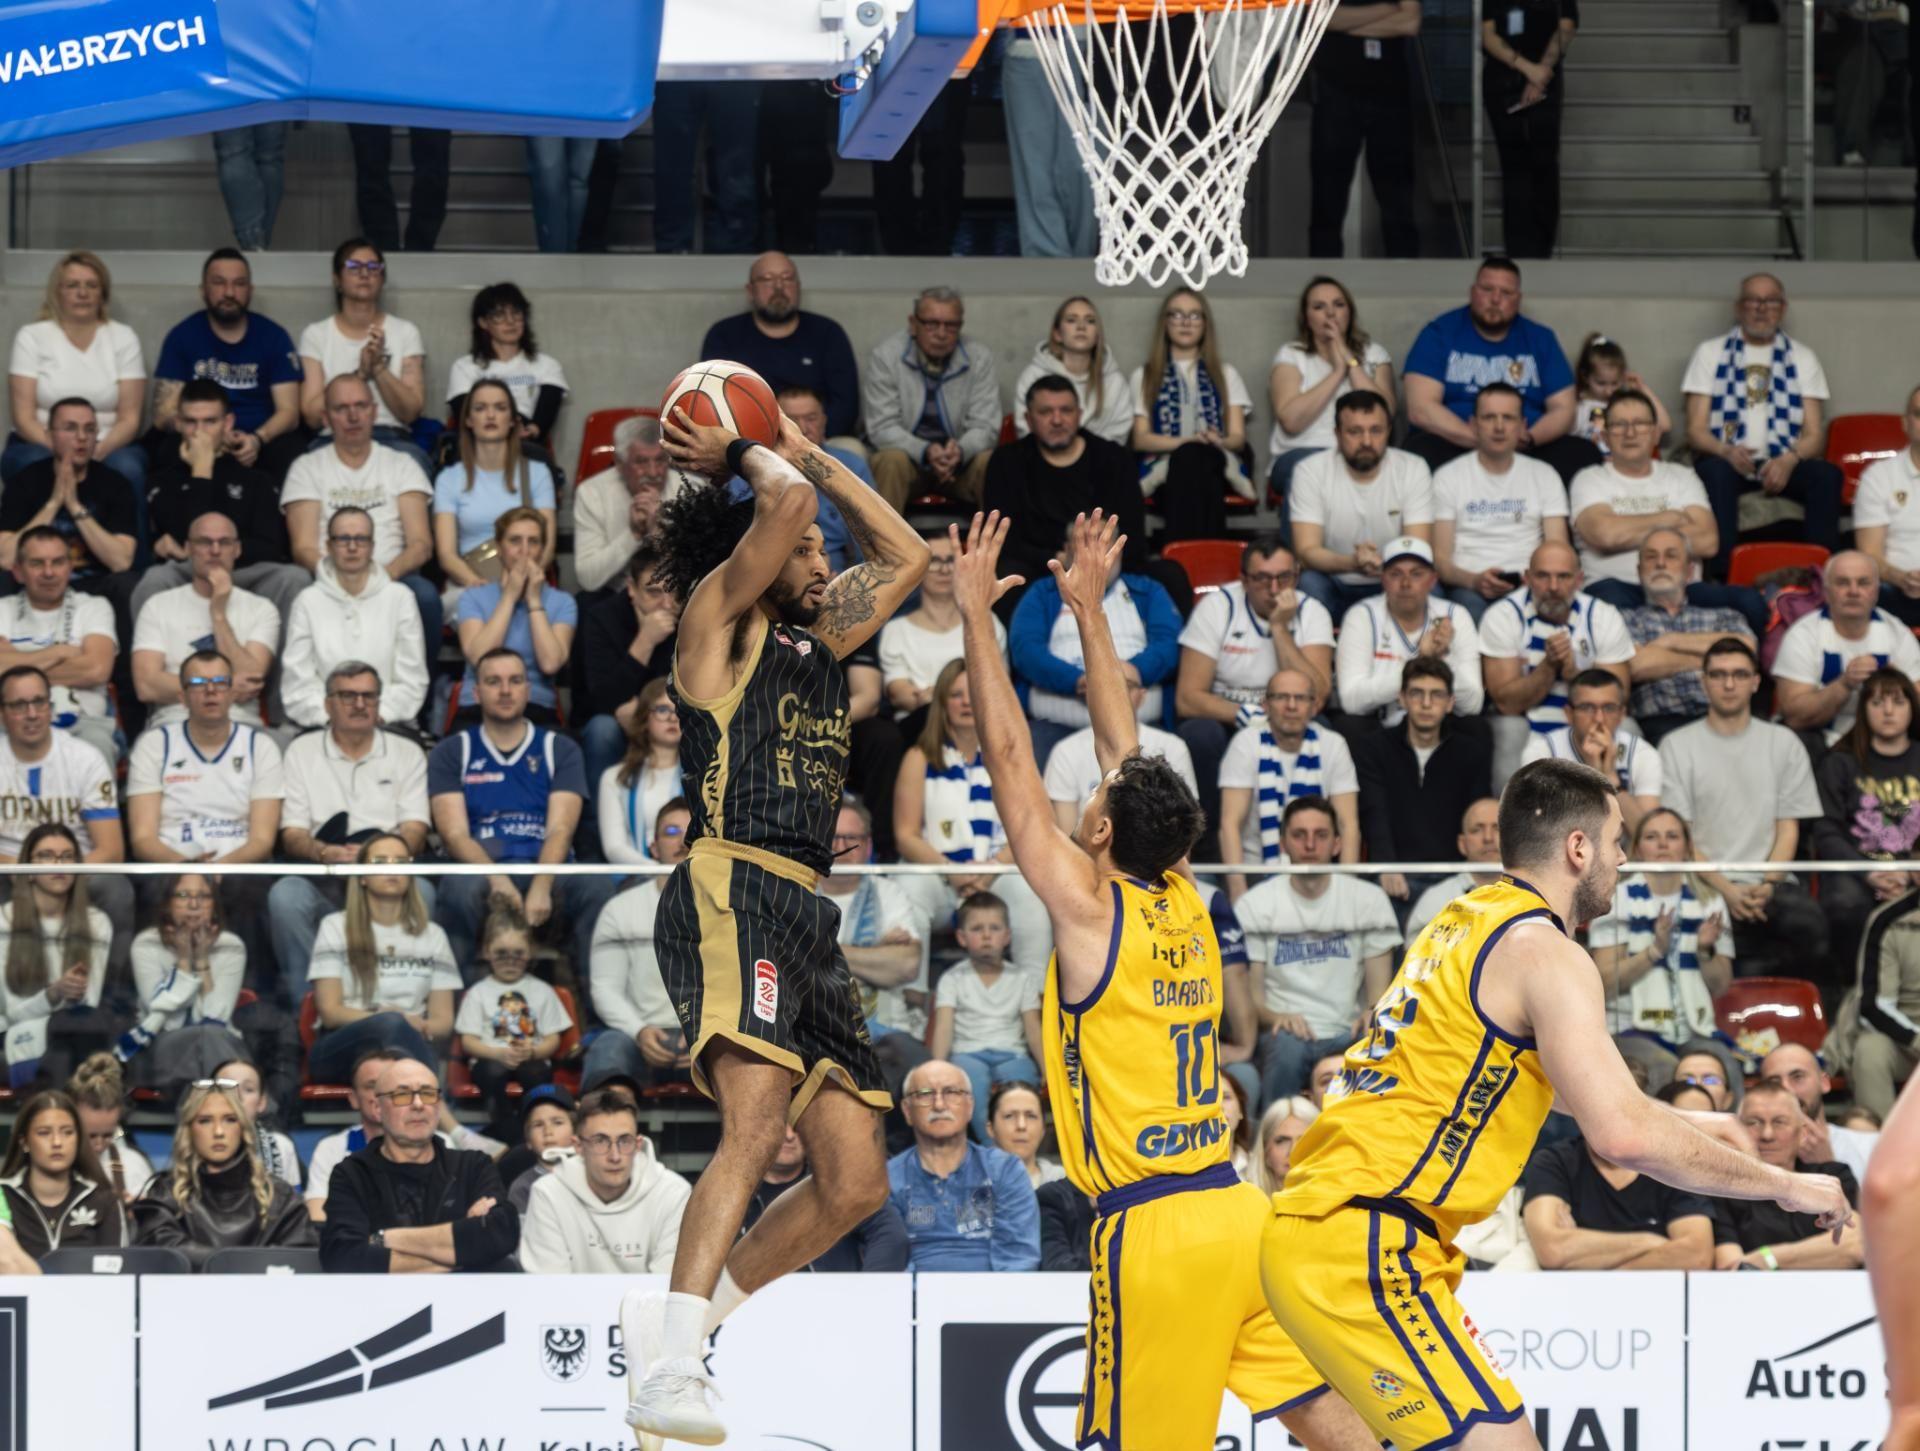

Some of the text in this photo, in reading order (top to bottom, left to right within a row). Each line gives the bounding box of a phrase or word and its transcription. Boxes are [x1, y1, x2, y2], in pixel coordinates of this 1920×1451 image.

[0, 788, 81, 824] ÓRNIK
[1170, 1019, 1220, 1107] 10
[1438, 1065, 1509, 1168] AMW ARKA
[1136, 1117, 1228, 1159] GDYN
[1483, 1328, 1652, 1371] GROUP
[1745, 1359, 1866, 1399] Auto
[1386, 1400, 1426, 1422] netia
